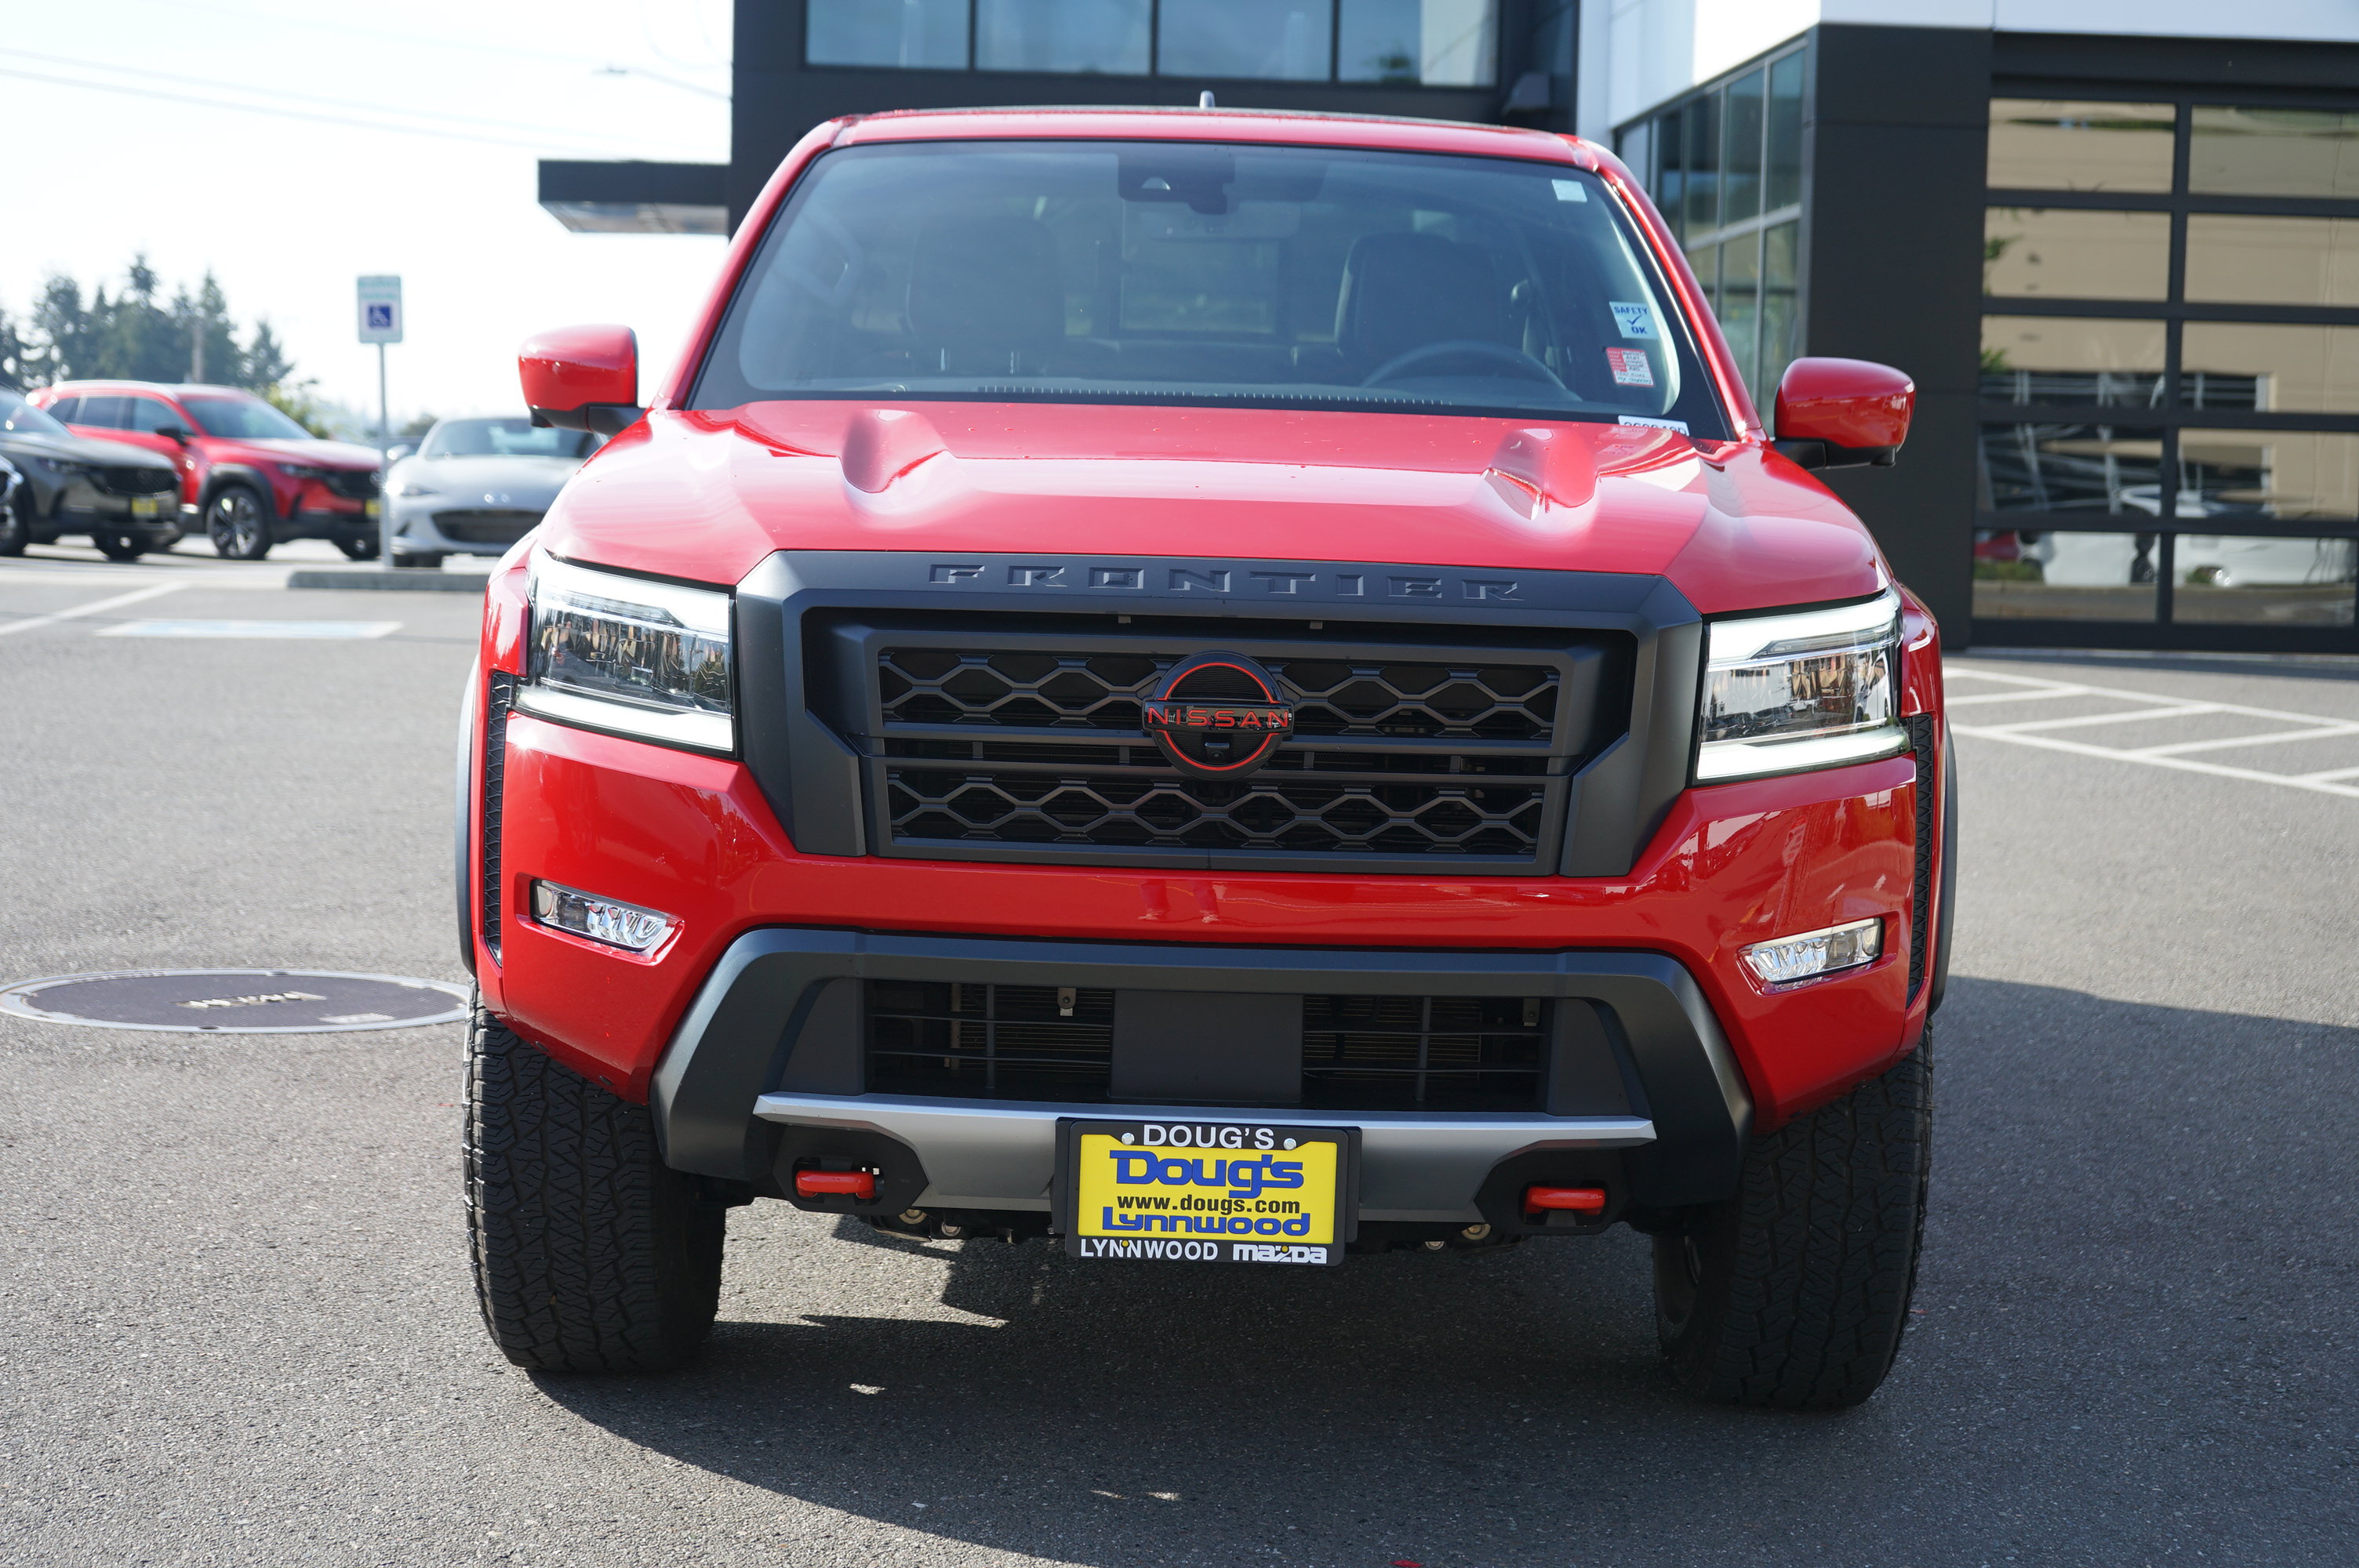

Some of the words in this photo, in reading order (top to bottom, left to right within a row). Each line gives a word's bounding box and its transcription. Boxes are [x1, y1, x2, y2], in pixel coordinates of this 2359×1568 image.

[929, 564, 1525, 602] FRONTIER
[1148, 707, 1289, 728] NISSAN
[1143, 1124, 1274, 1150] DOUG'S
[1110, 1149, 1304, 1198] Doug's
[1117, 1194, 1300, 1214] www.dougs.com
[1102, 1207, 1310, 1236] Lynnwood
[1080, 1239, 1219, 1260] LYNNWOOD
